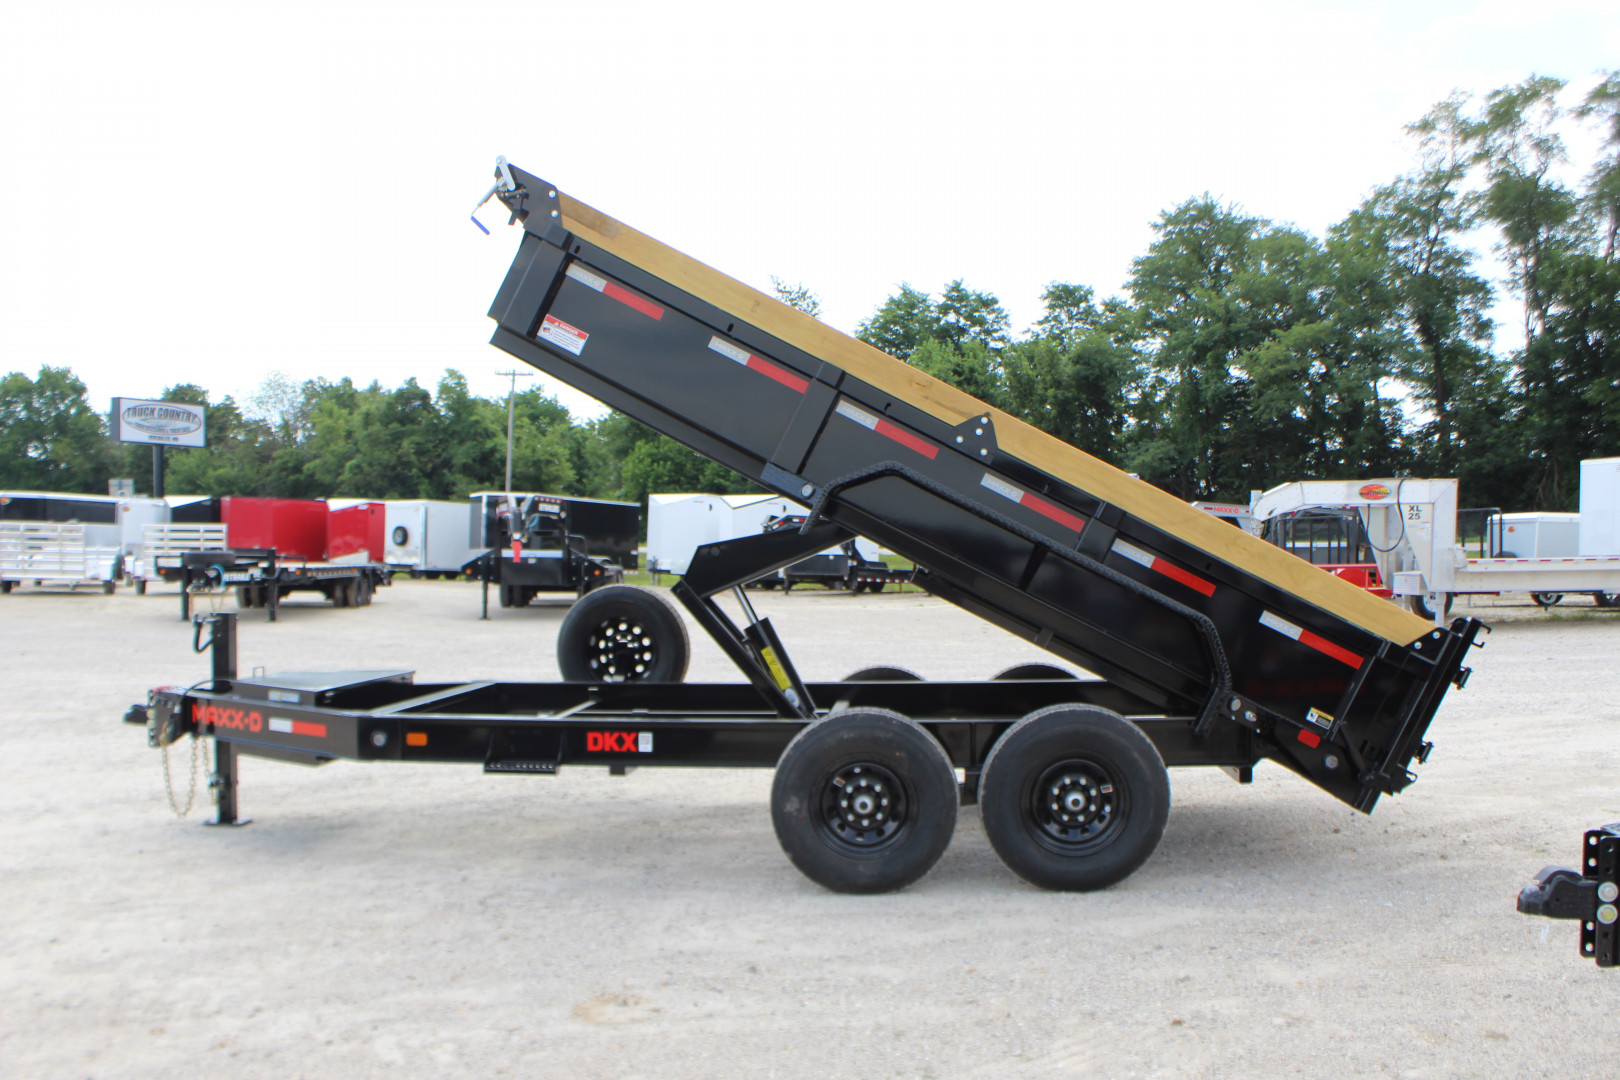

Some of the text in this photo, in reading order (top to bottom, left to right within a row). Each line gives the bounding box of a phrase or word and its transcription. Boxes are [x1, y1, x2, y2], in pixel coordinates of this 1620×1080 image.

[127, 407, 198, 424] TRUCK COUNTRY
[1214, 506, 1240, 514] MAXX-D
[1408, 512, 1421, 520] 25
[192, 704, 263, 733] MAXX-D
[586, 731, 638, 752] DKX
